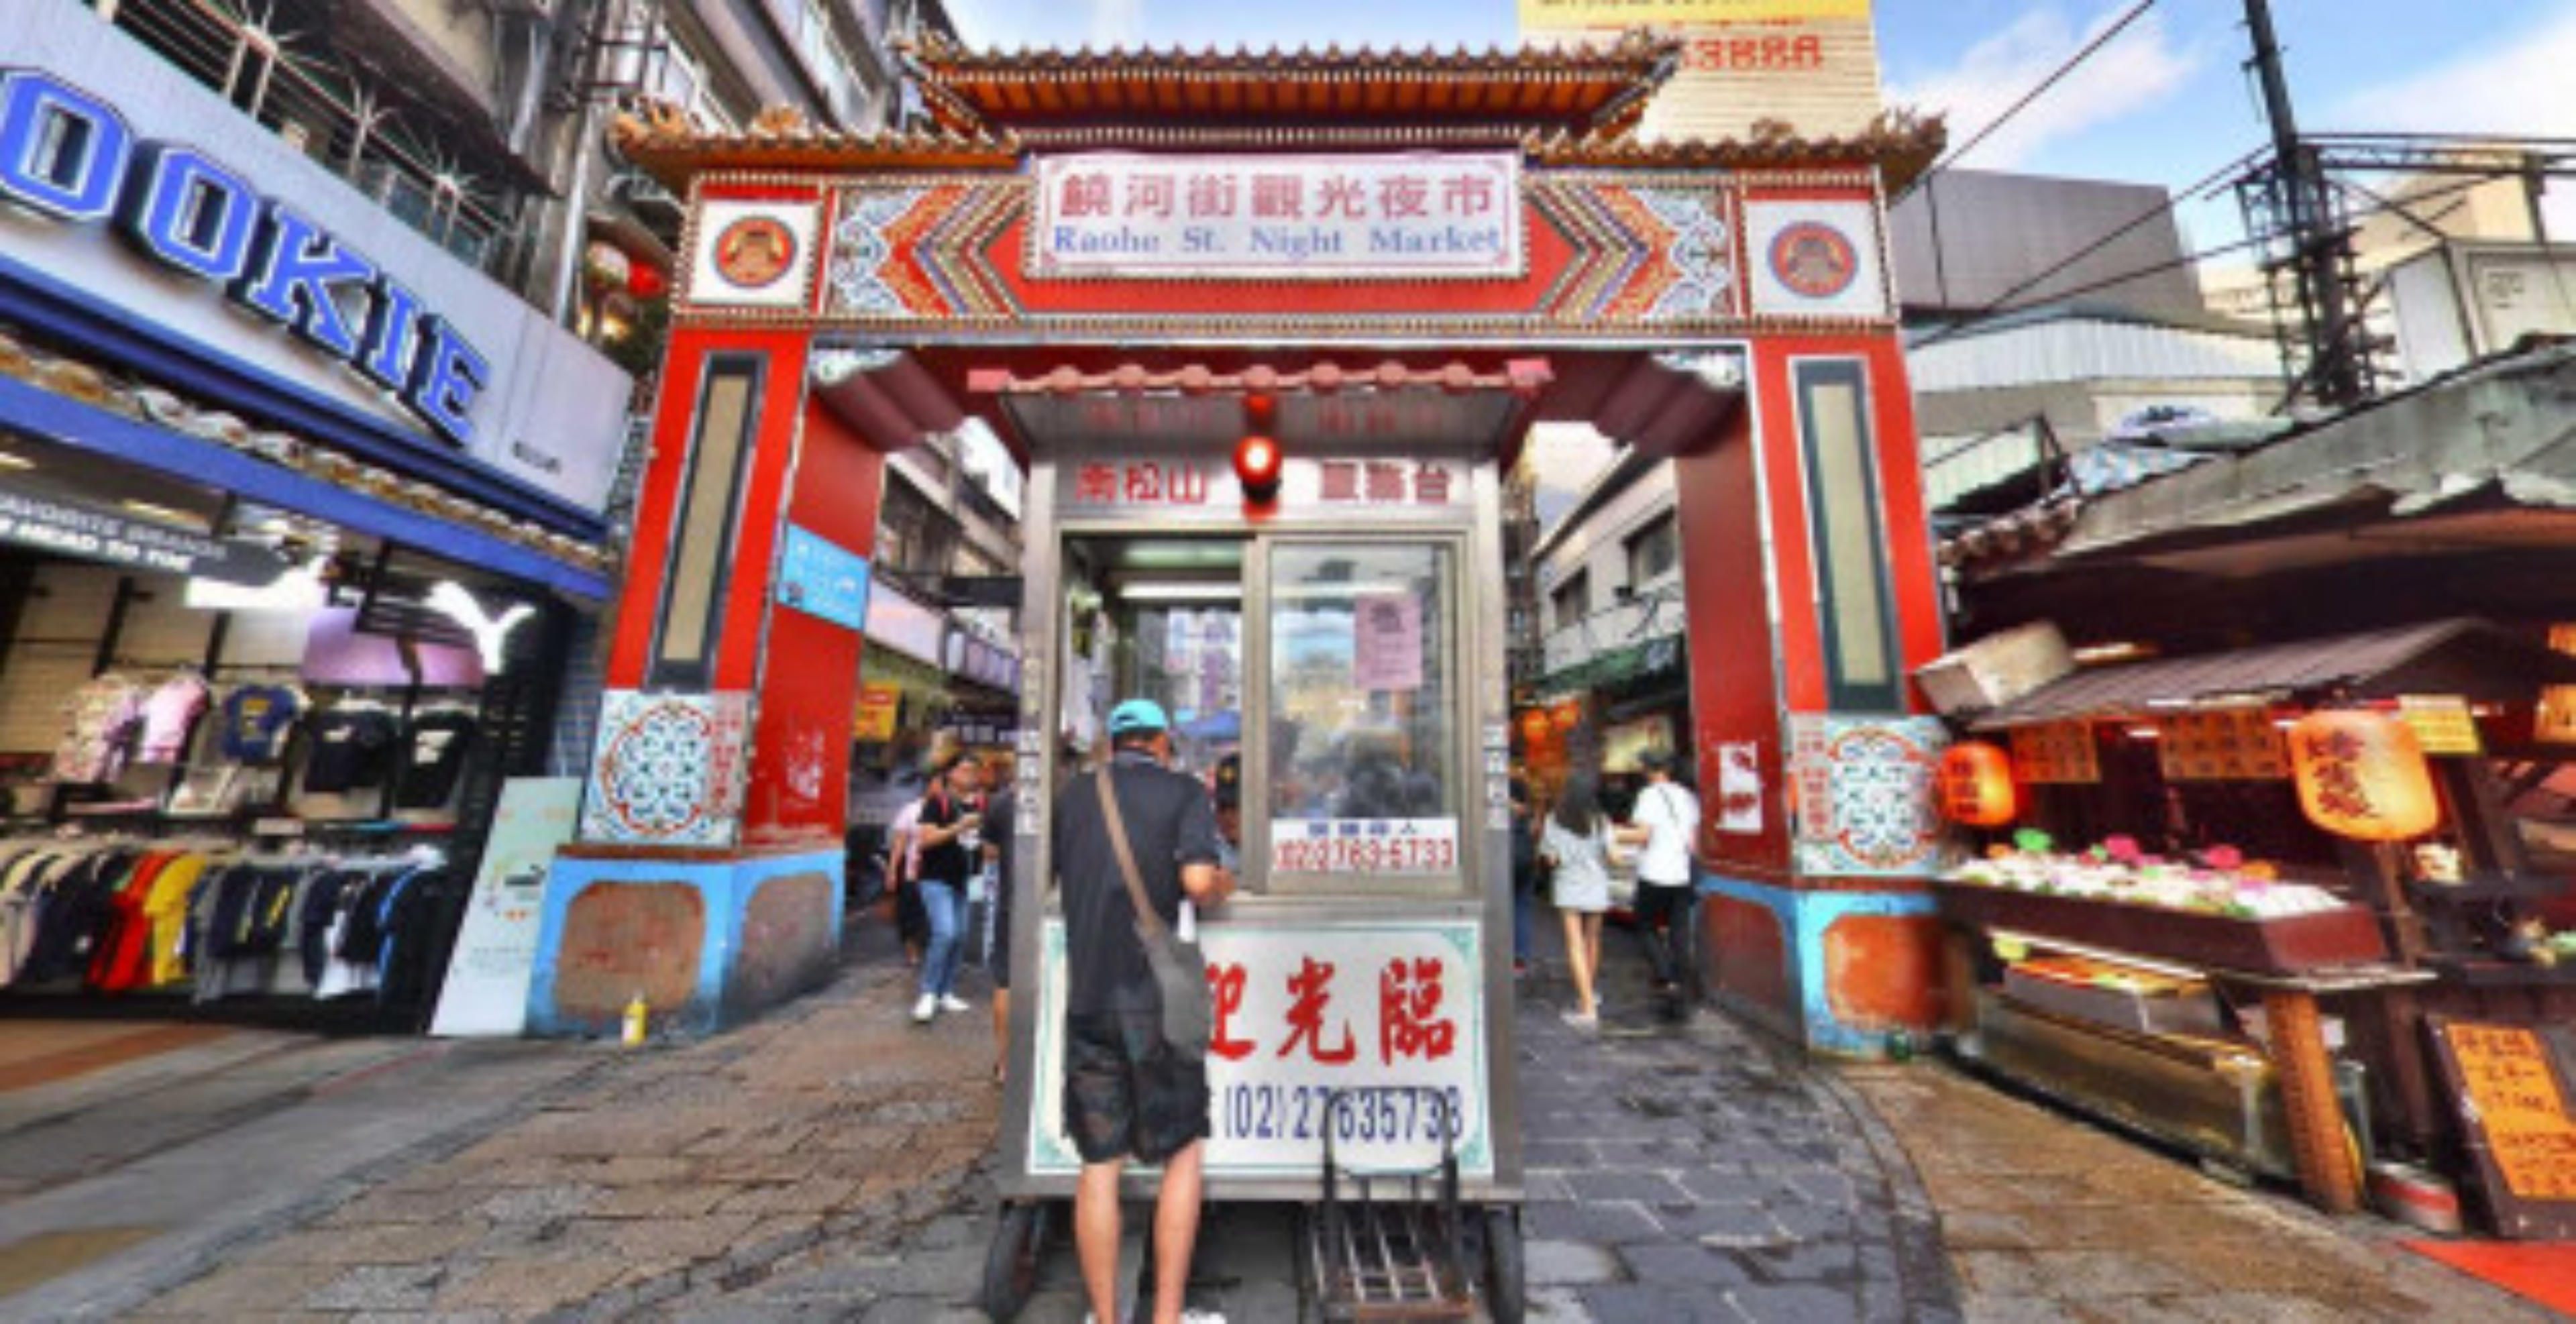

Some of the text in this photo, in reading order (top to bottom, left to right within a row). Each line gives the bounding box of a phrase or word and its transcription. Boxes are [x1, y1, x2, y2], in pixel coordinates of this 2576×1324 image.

[1060, 173, 1494, 219] 饒河街觀光夜市
[1055, 225, 1160, 254] Raohe
[1250, 225, 1342, 260] Night
[1369, 225, 1501, 254] Market
